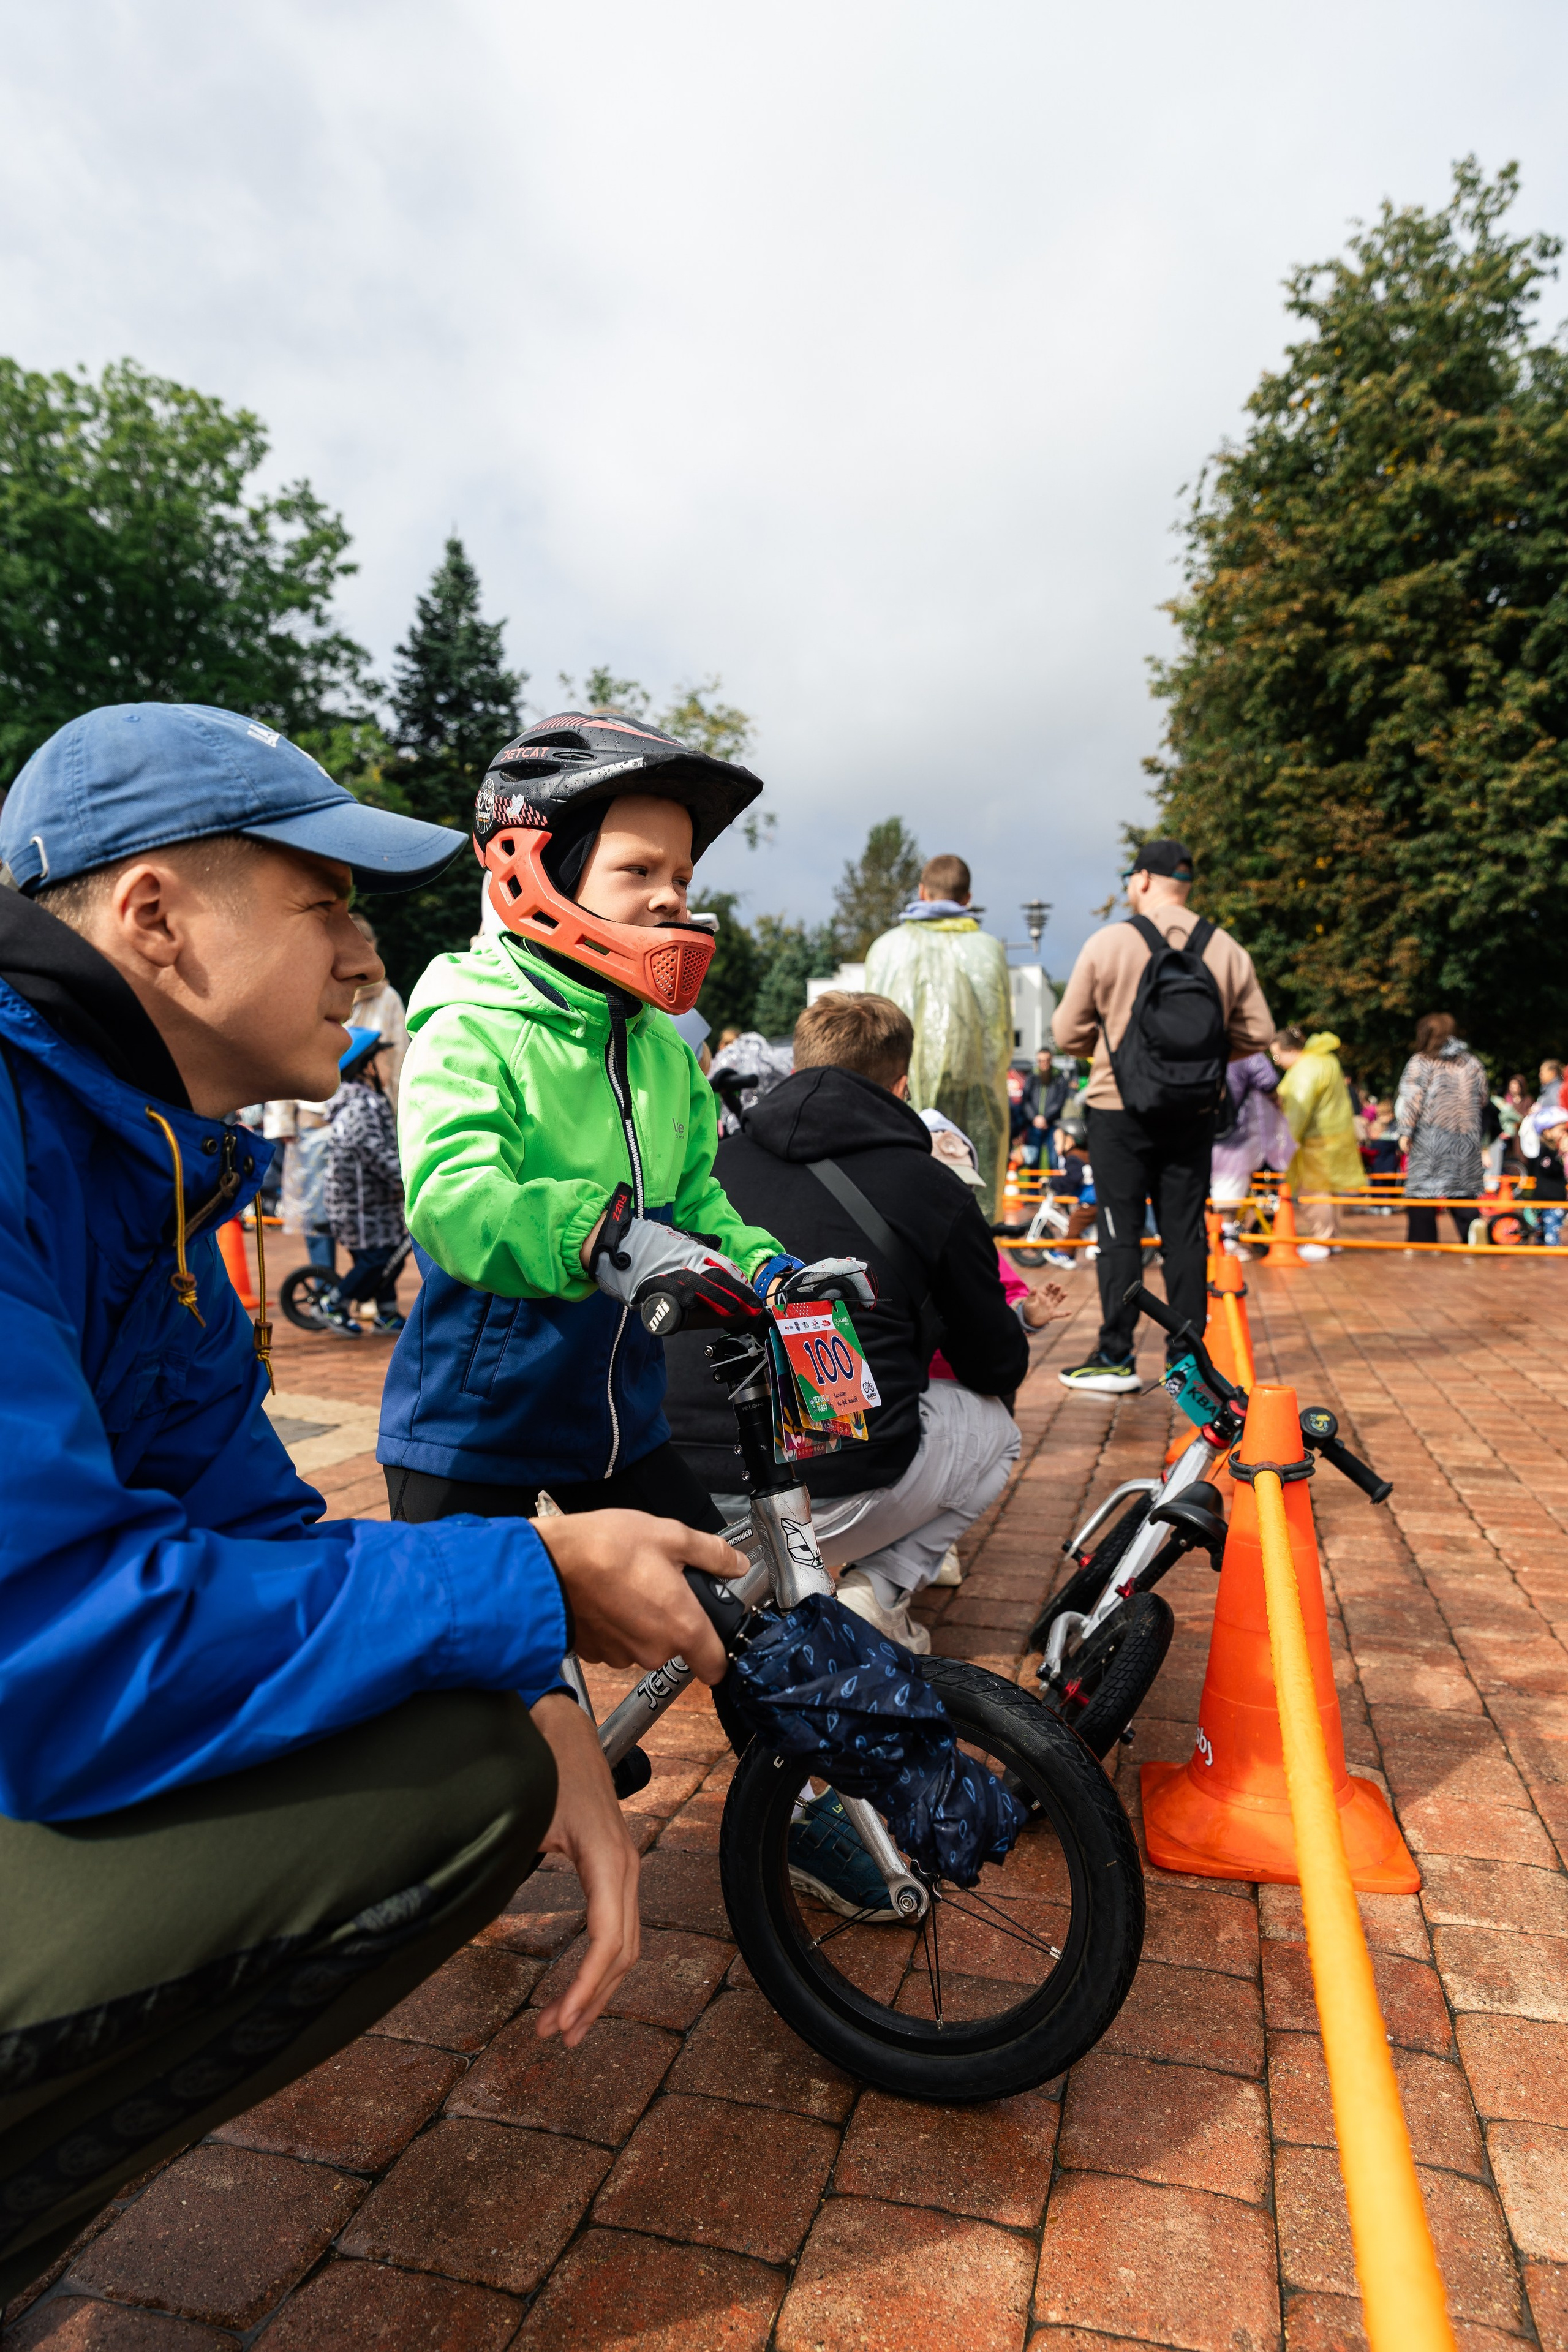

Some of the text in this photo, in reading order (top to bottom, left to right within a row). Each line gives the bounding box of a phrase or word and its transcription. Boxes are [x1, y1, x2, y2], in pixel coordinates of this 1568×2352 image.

[500, 747, 549, 761] JETCAT
[612, 1194, 628, 1222] FUZZ
[803, 1335, 854, 1386] 100
[742, 1401, 764, 1411] RISK
